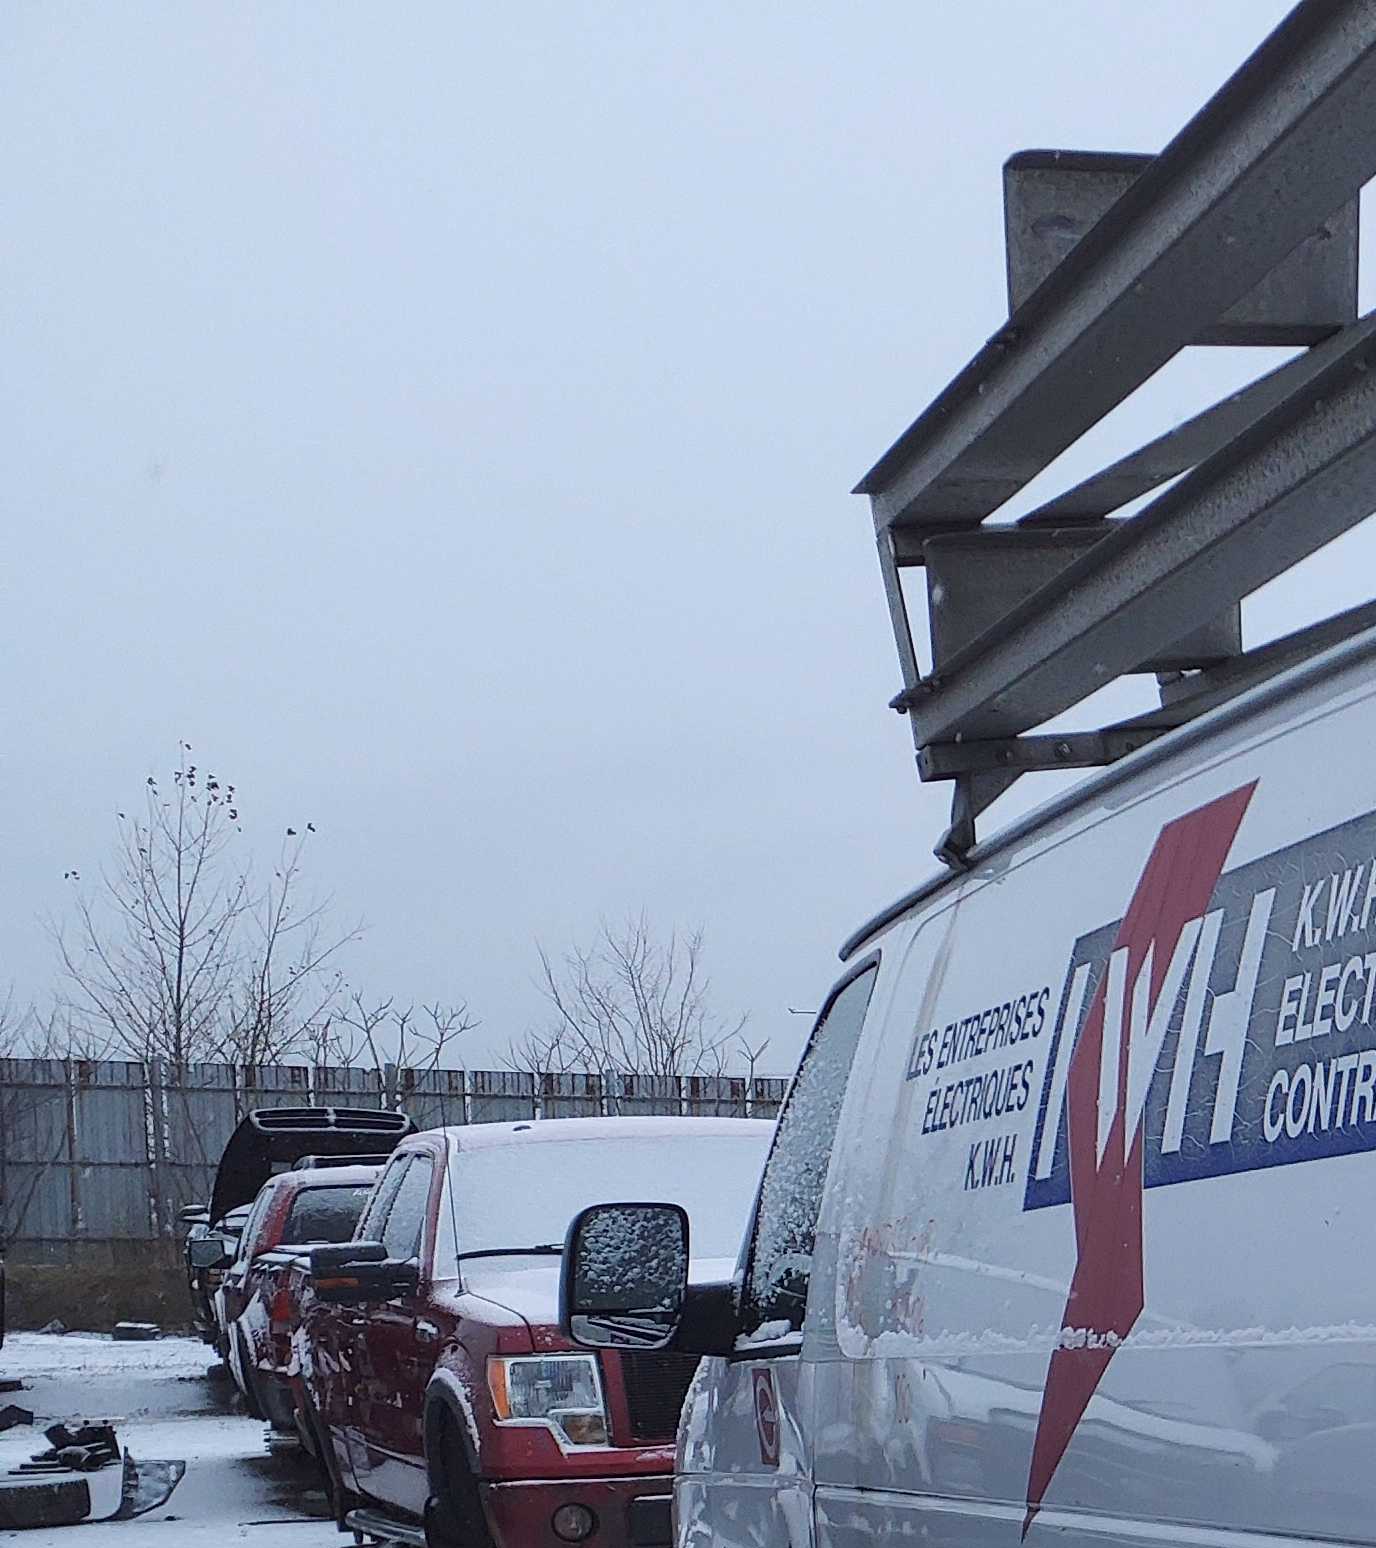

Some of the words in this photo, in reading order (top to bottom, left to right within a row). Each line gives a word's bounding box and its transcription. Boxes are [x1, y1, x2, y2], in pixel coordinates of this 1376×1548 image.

[906, 1029, 938, 1081] LES
[936, 986, 1050, 1070] ENTREPRISES
[921, 1059, 1034, 1135] ÉLECTRIQUES
